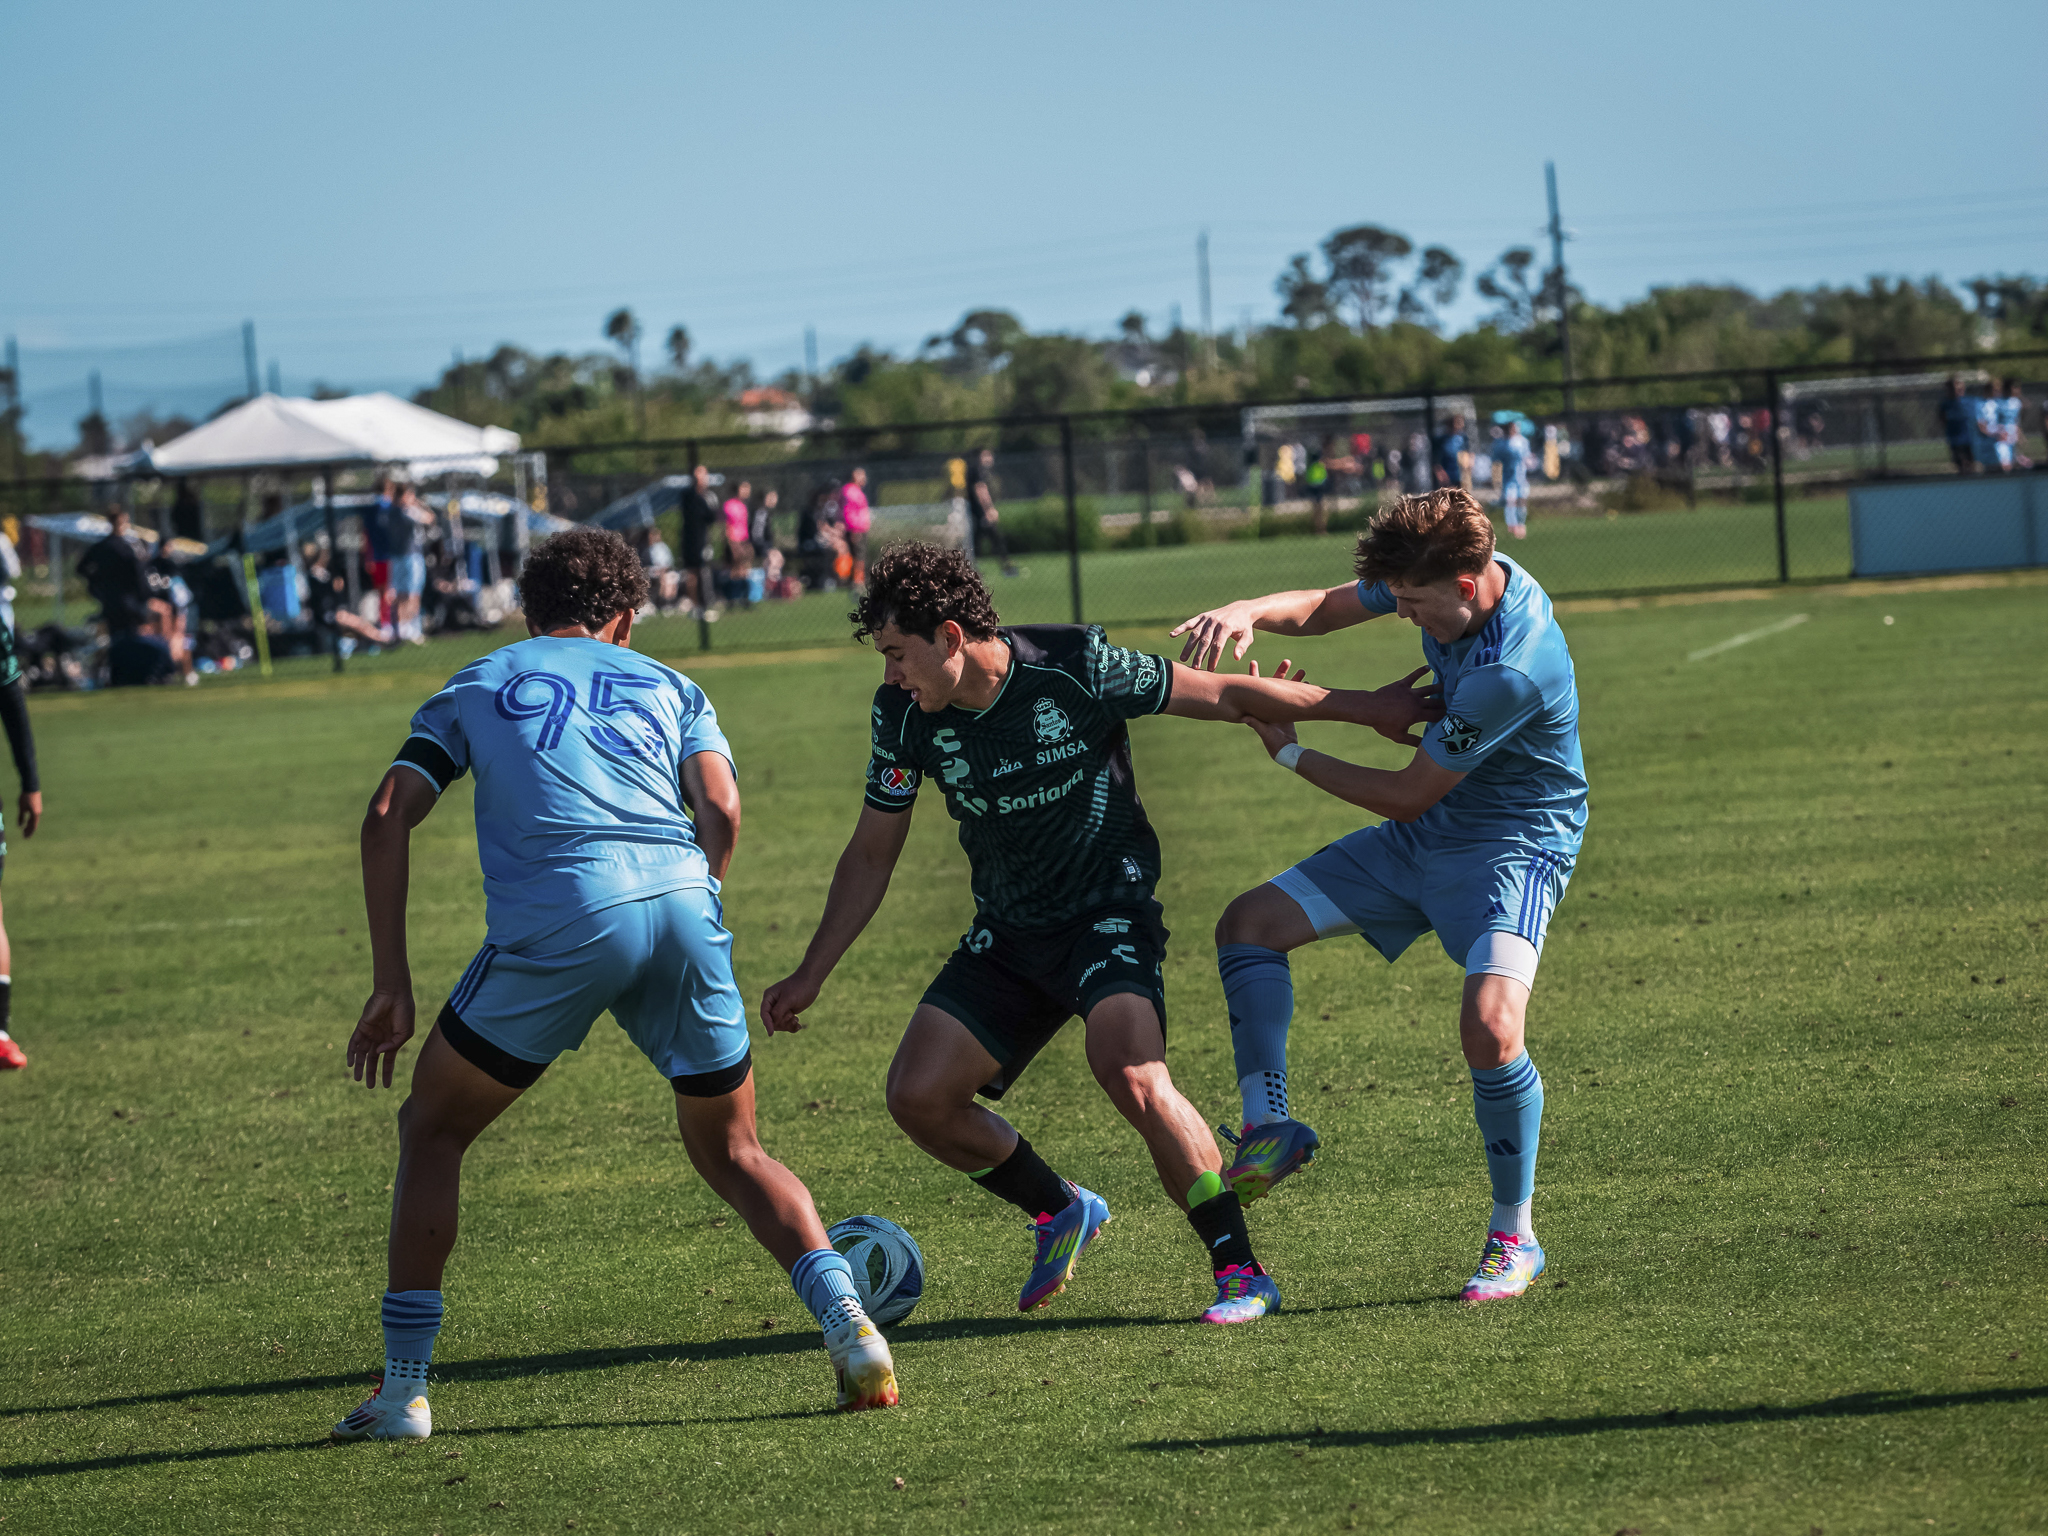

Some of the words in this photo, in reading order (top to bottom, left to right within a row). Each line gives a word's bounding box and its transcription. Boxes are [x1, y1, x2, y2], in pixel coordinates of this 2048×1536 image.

[494, 668, 664, 761] 95
[992, 761, 1024, 777] LALA
[1036, 739, 1089, 765] SIMSA
[997, 768, 1084, 814] Soriana
